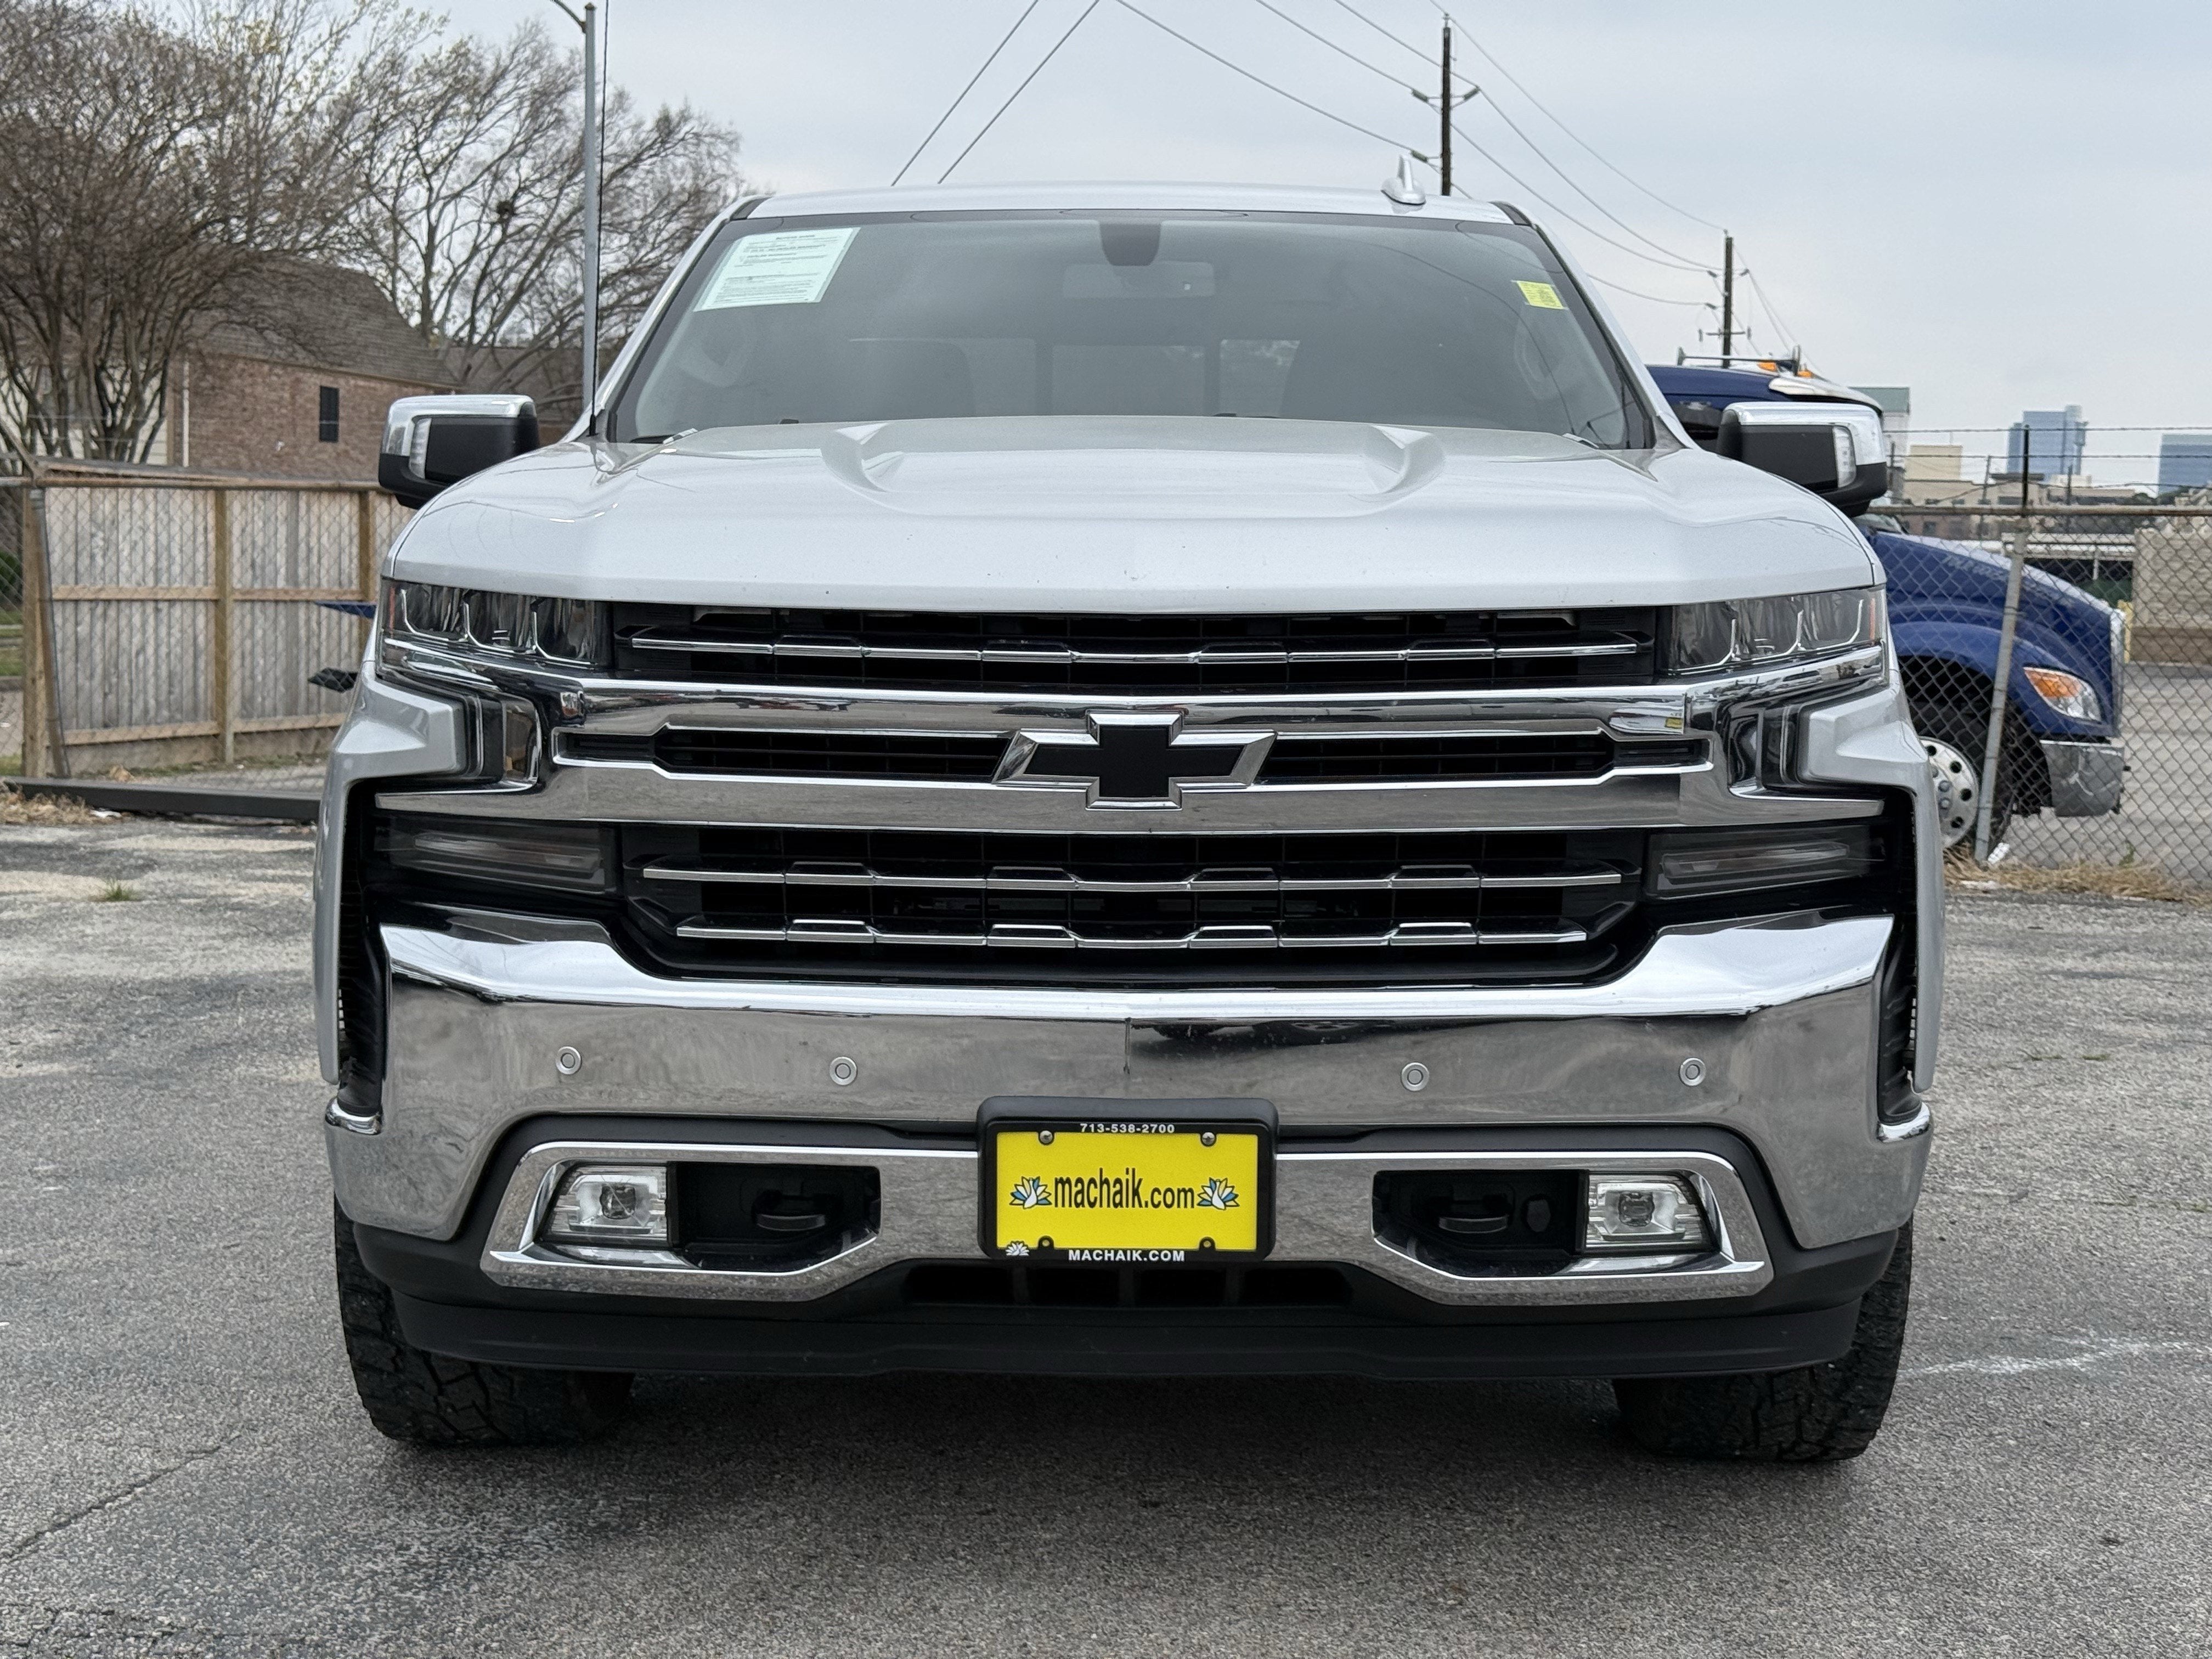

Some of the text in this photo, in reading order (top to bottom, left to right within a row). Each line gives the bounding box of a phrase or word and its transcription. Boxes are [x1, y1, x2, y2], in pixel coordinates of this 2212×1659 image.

[1080, 1123, 1175, 1133] 713-538-2700
[1054, 1167, 1195, 1209] machaik.com
[1068, 1249, 1185, 1262] MACHAIK.COM
